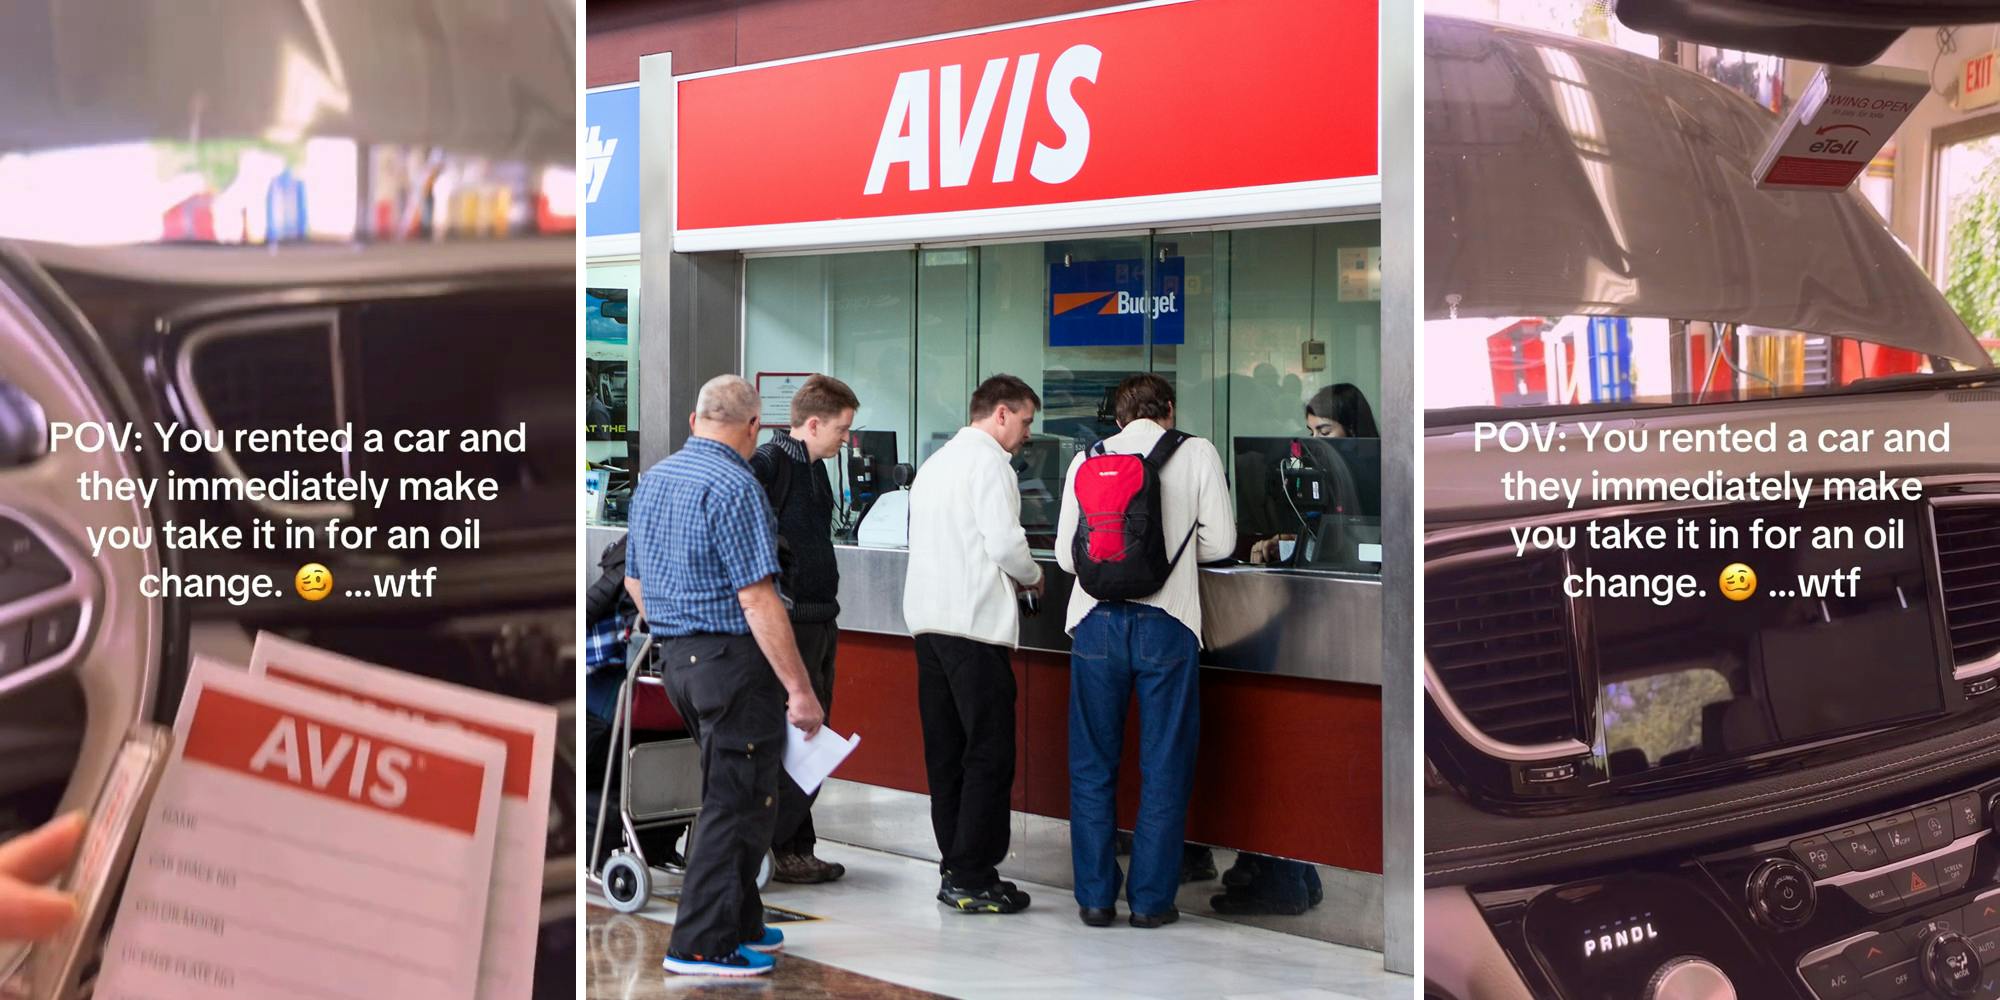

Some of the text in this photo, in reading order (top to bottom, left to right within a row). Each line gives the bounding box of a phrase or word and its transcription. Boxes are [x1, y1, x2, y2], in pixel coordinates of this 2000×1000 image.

[1966, 54, 1993, 93] EXIT
[1871, 99, 1914, 113] OPEN
[863, 43, 1103, 196] AVIS
[1808, 138, 1859, 155] eToll
[1118, 290, 1176, 320] Budget
[601, 424, 626, 433] THE
[250, 714, 413, 809] AVIS
[161, 807, 198, 831] NAME
[1932, 829, 1943, 838] OFF
[1943, 863, 1963, 875] SCREEN
[1950, 871, 1961, 880] OFF
[1868, 889, 1885, 900] MUTE
[1979, 941, 1996, 953] AUTO
[1895, 974, 1908, 985] OFF
[1954, 968, 1970, 980] MODE
[1831, 976, 1848, 987] A/C
